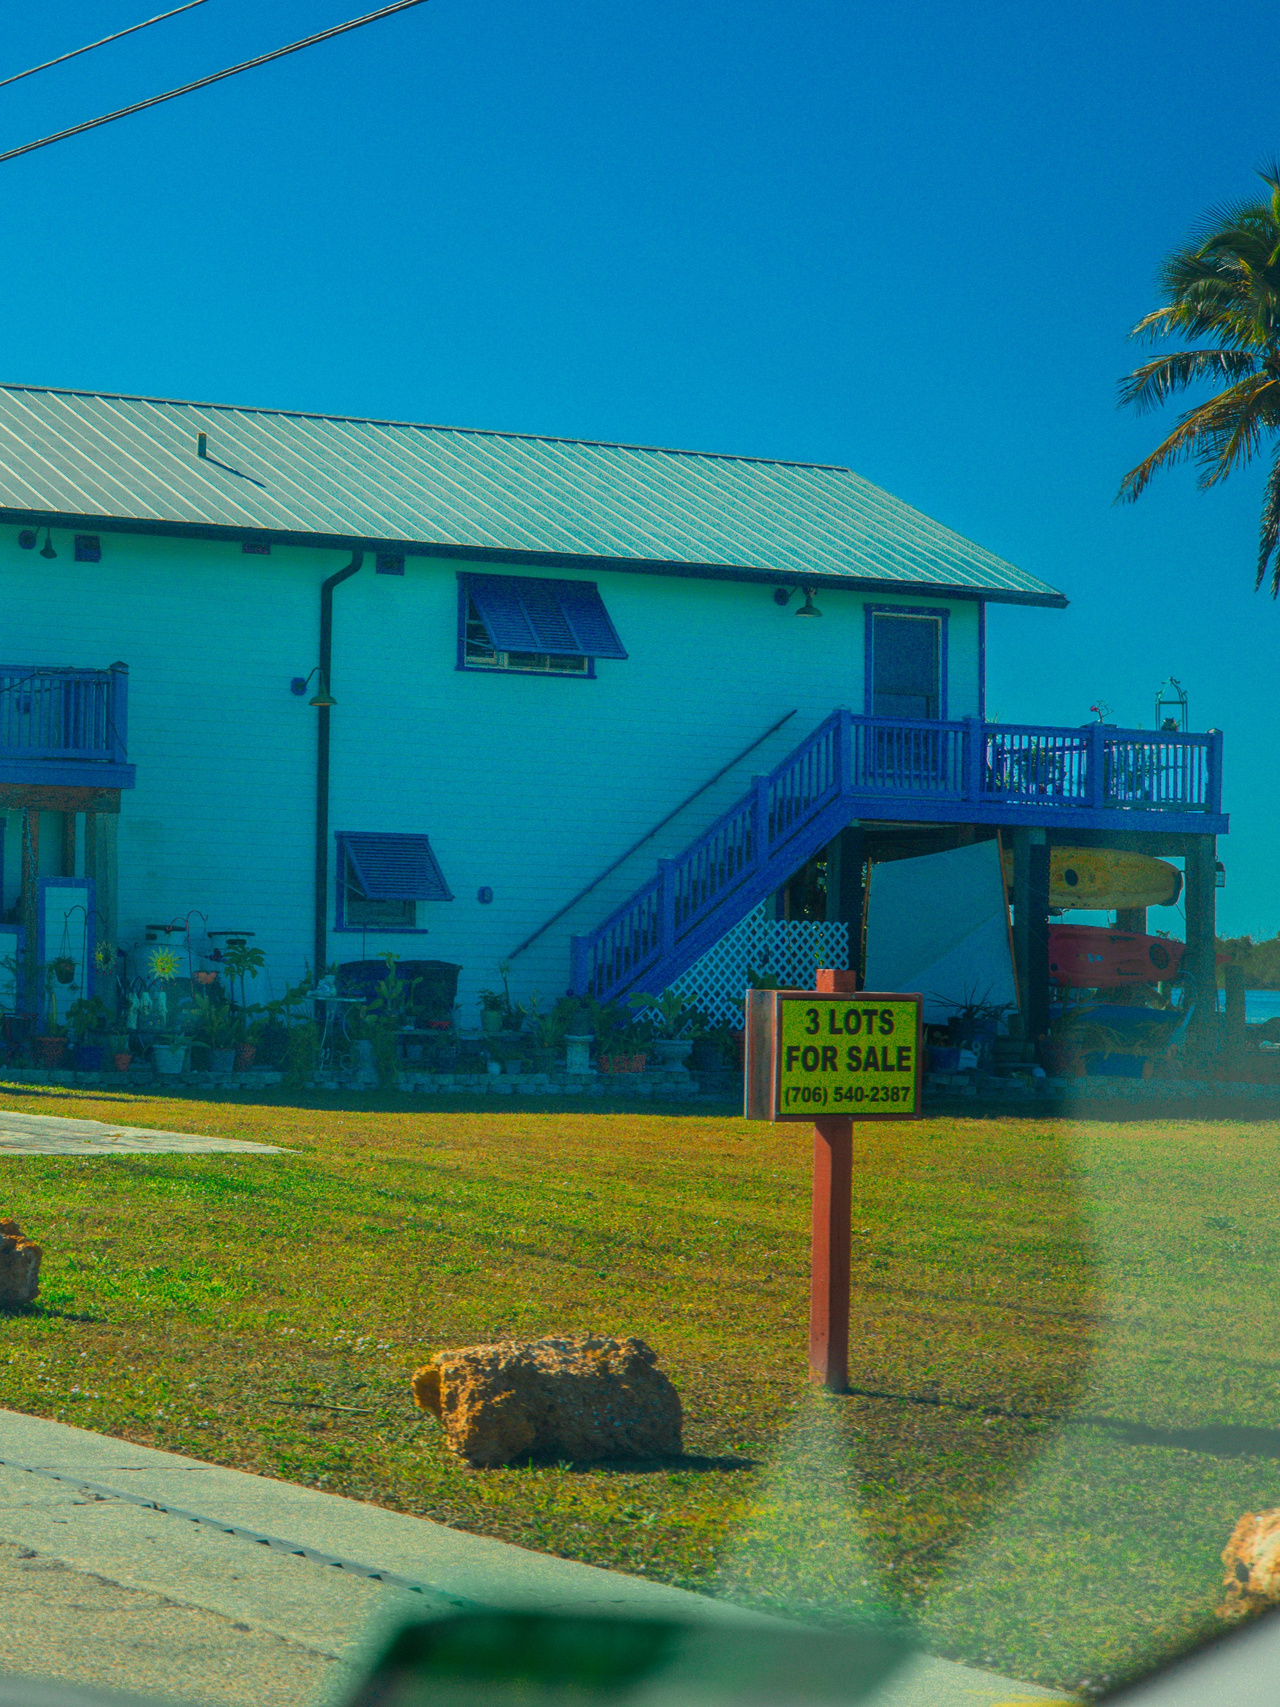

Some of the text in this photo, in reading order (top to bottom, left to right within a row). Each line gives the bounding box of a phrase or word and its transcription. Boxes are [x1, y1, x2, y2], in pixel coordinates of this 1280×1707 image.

[805, 1008, 894, 1035] 3 LOTS
[786, 1046, 911, 1072] FOR SALE
[786, 1087, 910, 1106] (706) 540-2387
